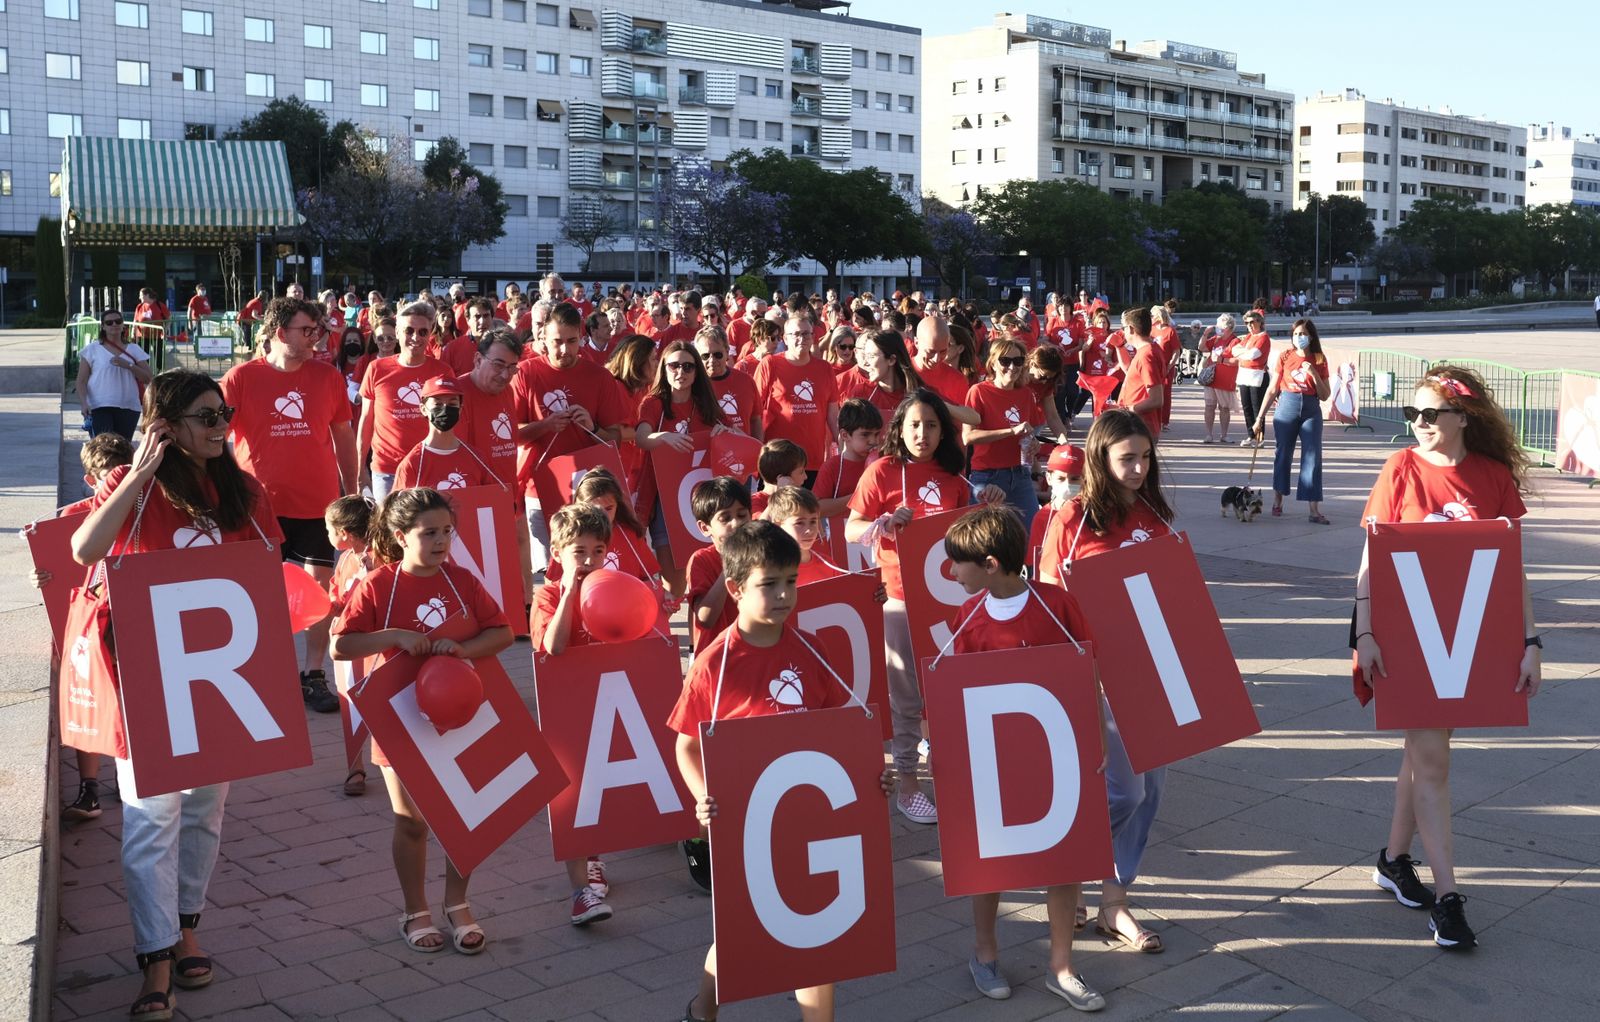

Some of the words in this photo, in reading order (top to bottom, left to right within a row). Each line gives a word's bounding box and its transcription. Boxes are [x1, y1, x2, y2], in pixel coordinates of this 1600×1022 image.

[271, 423, 290, 431] regala
[292, 421, 308, 429] VIDA
[286, 430, 311, 438] órganos
[150, 579, 284, 756] R
[1123, 573, 1202, 727] I
[1391, 549, 1500, 699] V
[388, 658, 539, 832] E
[573, 670, 684, 828] A
[963, 683, 1081, 859] D
[743, 750, 866, 949] G
